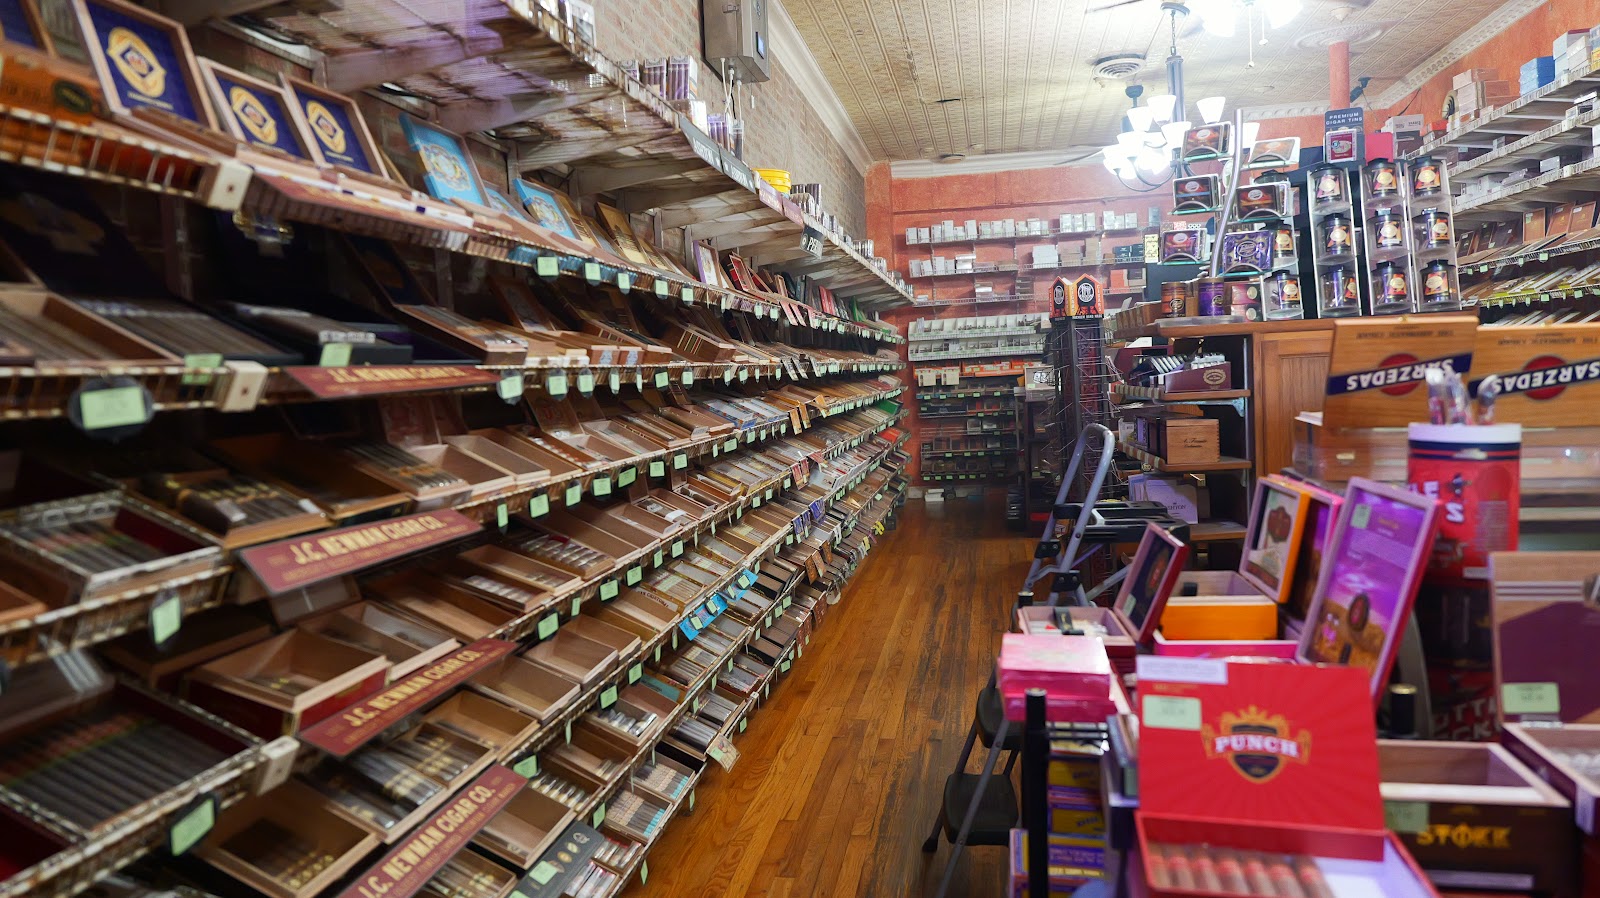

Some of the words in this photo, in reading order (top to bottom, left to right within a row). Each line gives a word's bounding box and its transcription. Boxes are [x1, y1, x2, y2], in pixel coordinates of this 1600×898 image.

[1347, 358, 1454, 390] SARZEDAS
[1493, 360, 1600, 393] SARZEDAS
[289, 541, 328, 565] J.C.
[318, 527, 390, 557] NEWMAN
[381, 519, 427, 540] CIGAR
[419, 515, 448, 531] CO.
[342, 707, 381, 727] J.C.
[367, 676, 434, 711] NEWMAN
[423, 655, 467, 681] CIGAR
[456, 649, 484, 663] CO.
[1214, 734, 1299, 758] PUNCH
[381, 826, 446, 882] NEWMAN
[435, 798, 479, 833] CIGAR
[468, 785, 496, 804] CO.
